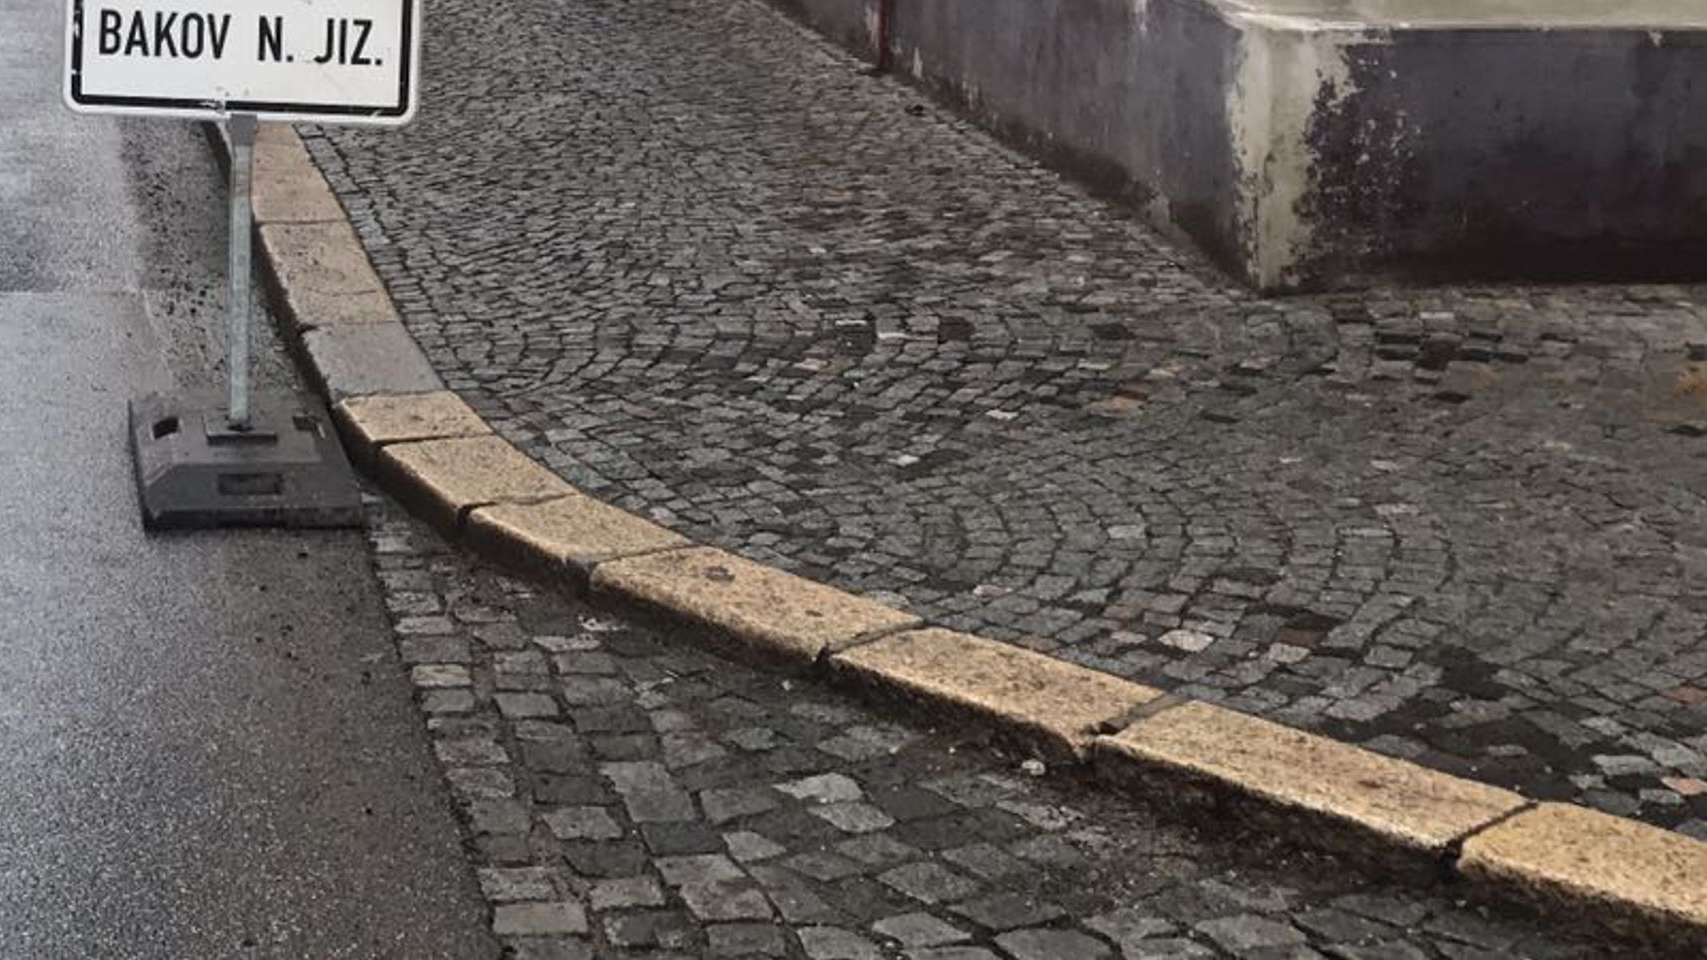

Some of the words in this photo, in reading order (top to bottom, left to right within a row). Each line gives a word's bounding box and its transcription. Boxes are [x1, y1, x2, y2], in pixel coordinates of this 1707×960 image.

[98, 8, 231, 59] BAKOV
[257, 15, 295, 63] N.
[314, 18, 383, 66] JIZ.
